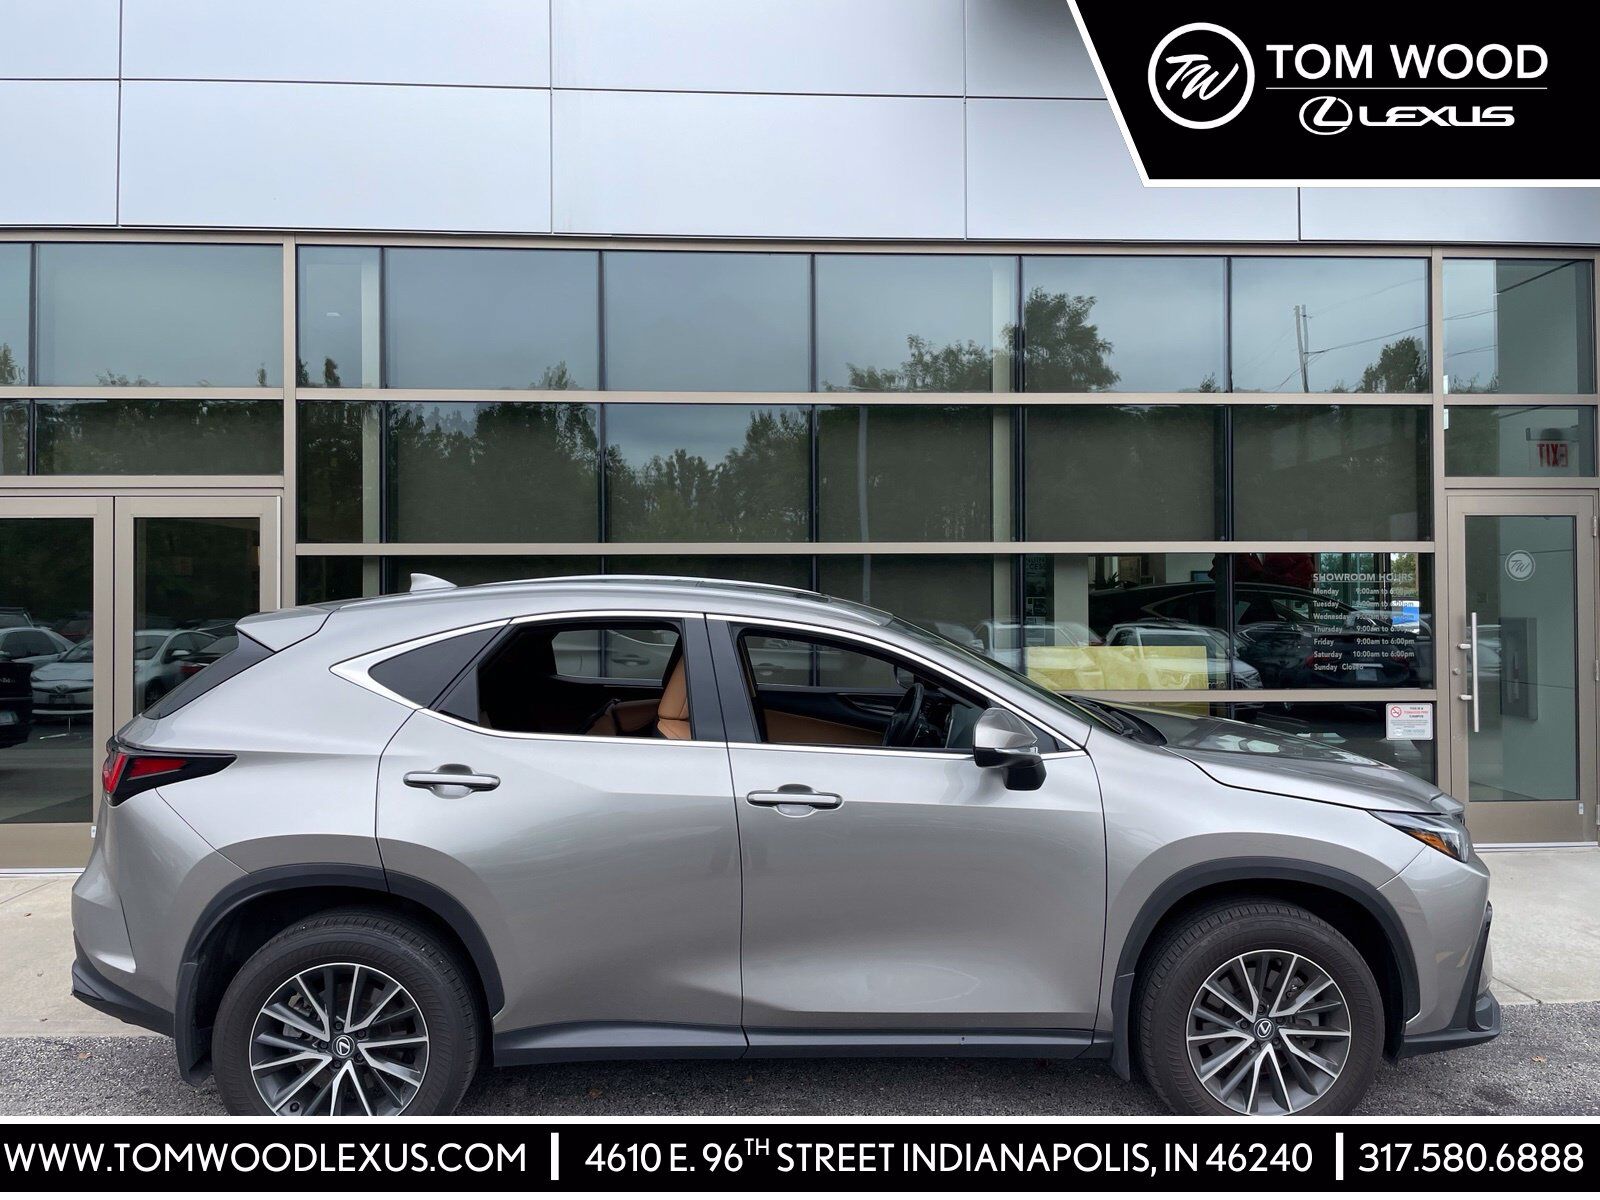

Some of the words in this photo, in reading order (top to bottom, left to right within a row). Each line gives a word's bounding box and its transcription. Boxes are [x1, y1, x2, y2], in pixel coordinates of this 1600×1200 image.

[1313, 573, 1376, 581] SHOWROOM
[1379, 573, 1413, 581] HOURS
[1313, 588, 1339, 596] Monday
[1313, 600, 1339, 608] Tuesday
[1313, 613, 1349, 621] Wednesday
[1313, 638, 1334, 646] Friday
[1390, 638, 1415, 646] 6:00pm
[1313, 663, 1337, 672] Sunday
